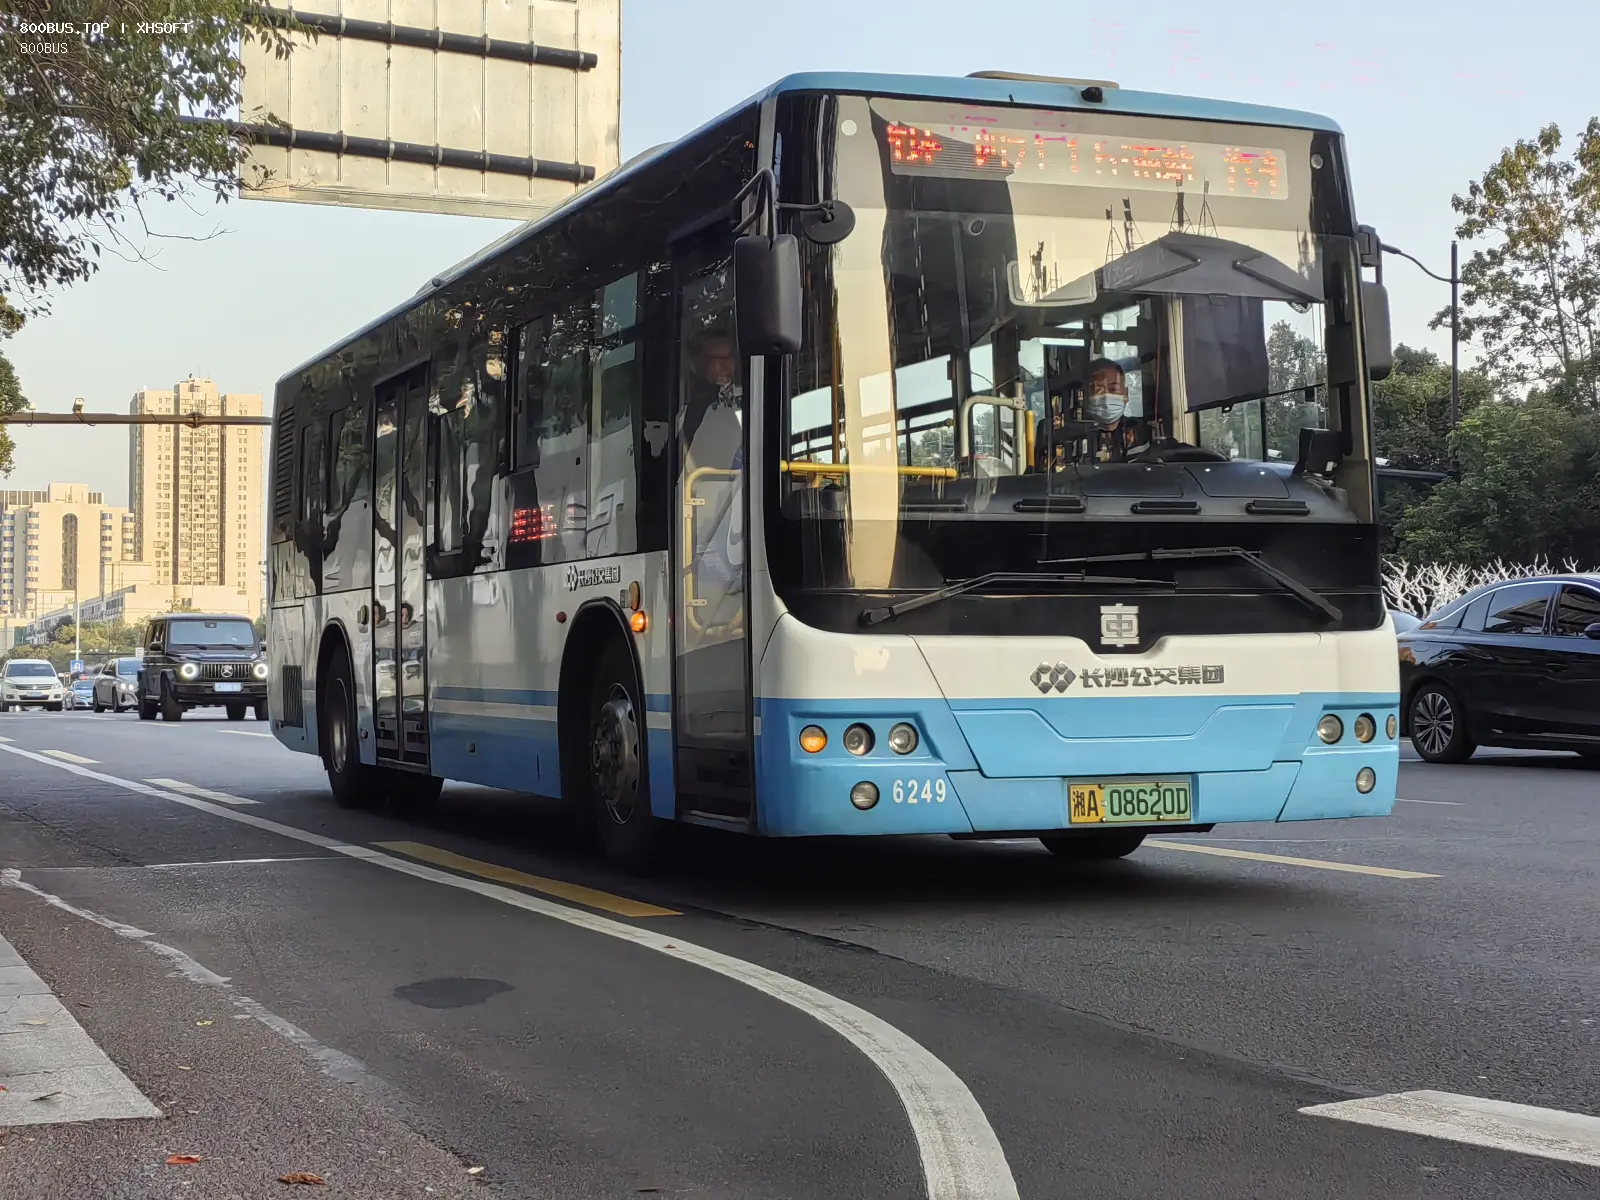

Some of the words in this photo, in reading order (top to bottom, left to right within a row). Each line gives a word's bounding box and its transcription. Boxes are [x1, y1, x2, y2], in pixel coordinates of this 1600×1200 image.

[1079, 664, 1225, 689] 长沙公交集团
[892, 779, 946, 804] 6249
